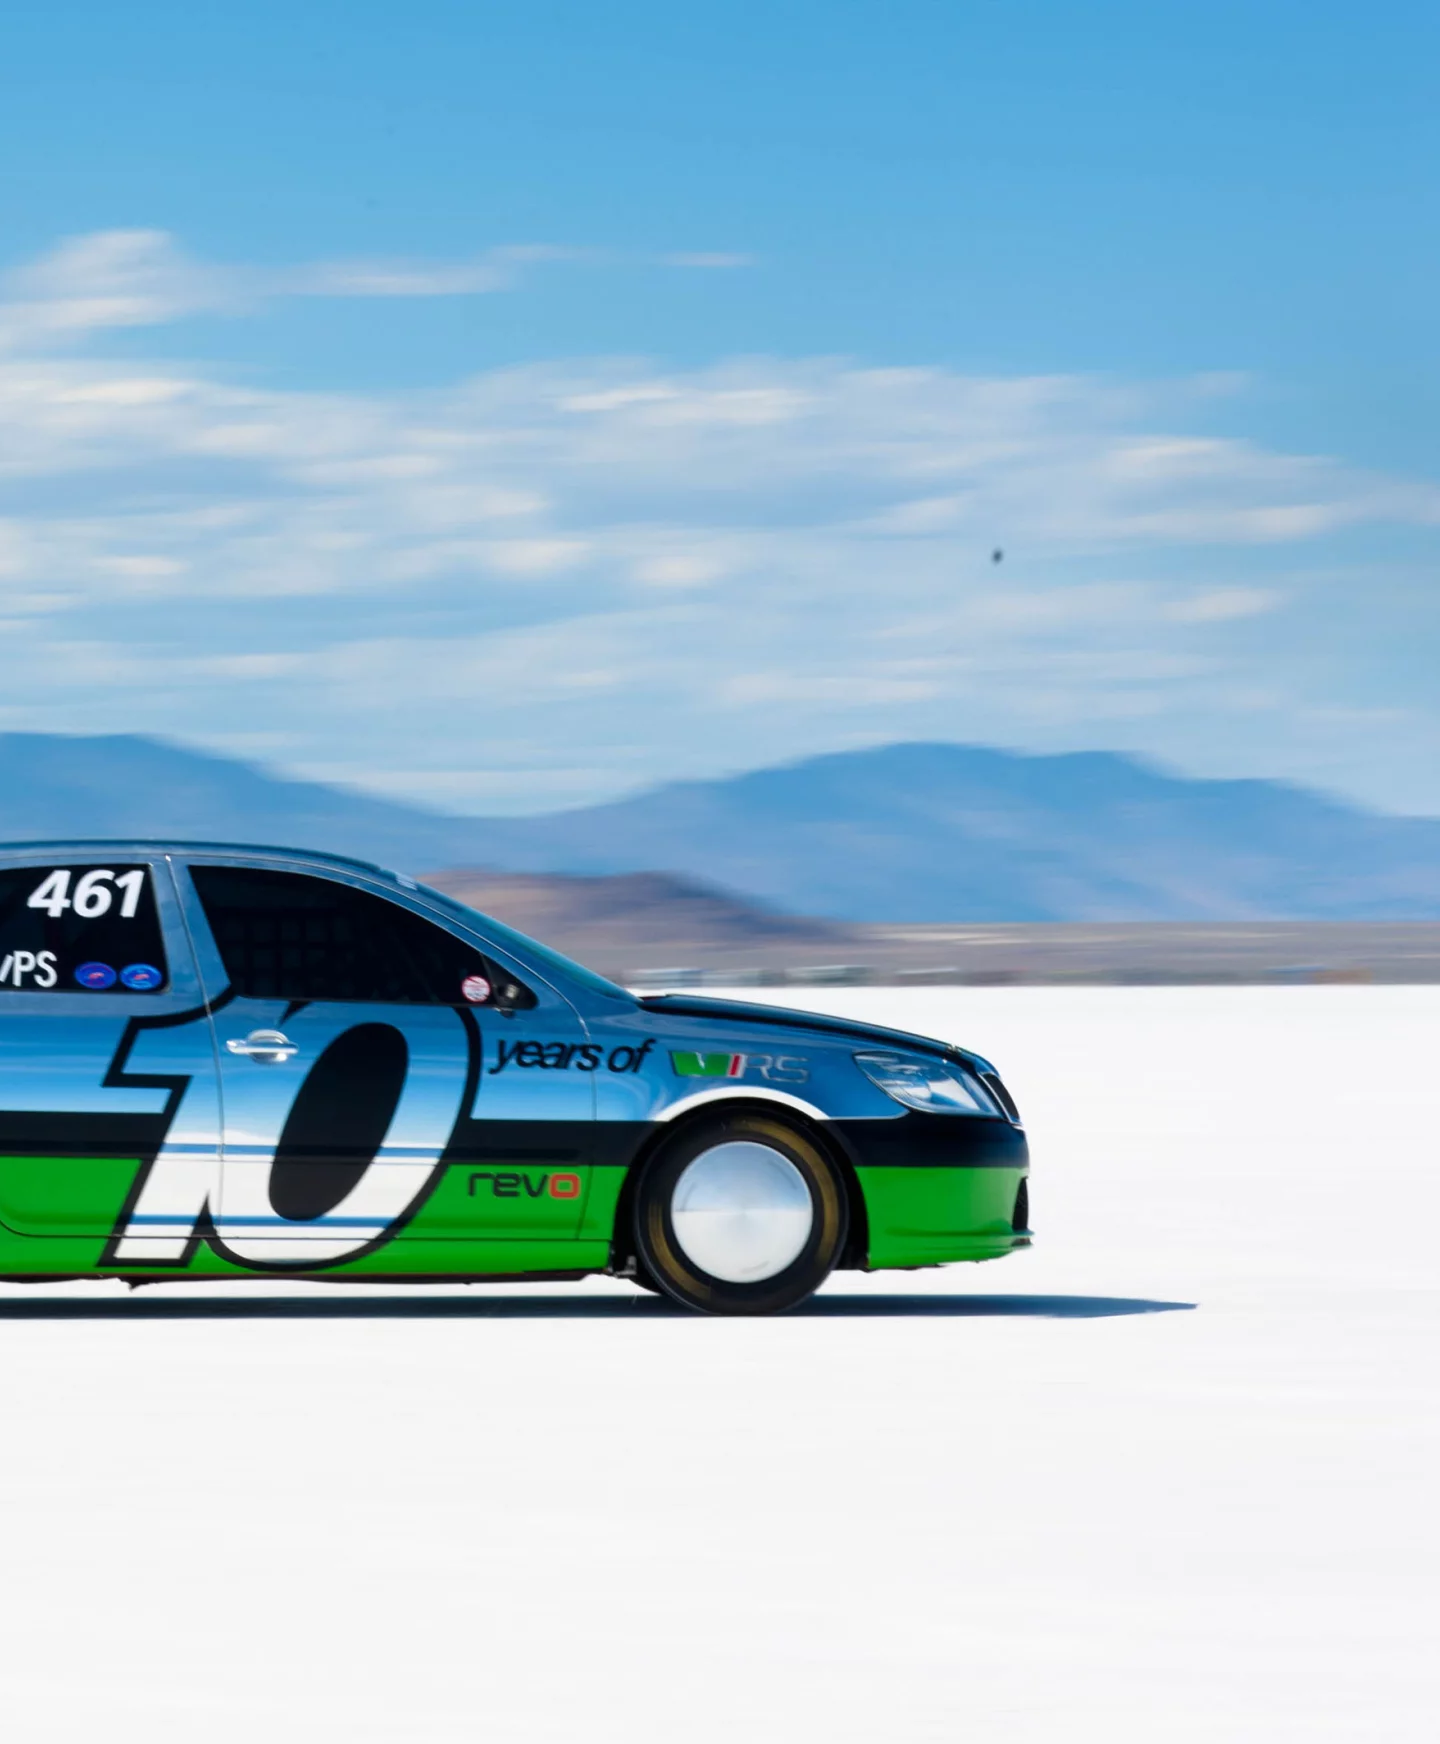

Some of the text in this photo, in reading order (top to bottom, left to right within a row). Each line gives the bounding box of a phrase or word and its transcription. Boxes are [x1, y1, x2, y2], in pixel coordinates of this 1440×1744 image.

[26, 869, 145, 918] 461
[96, 990, 482, 1272] 10
[488, 1038, 603, 1075] years
[607, 1038, 657, 1074] of
[468, 1172, 581, 1199] revo
